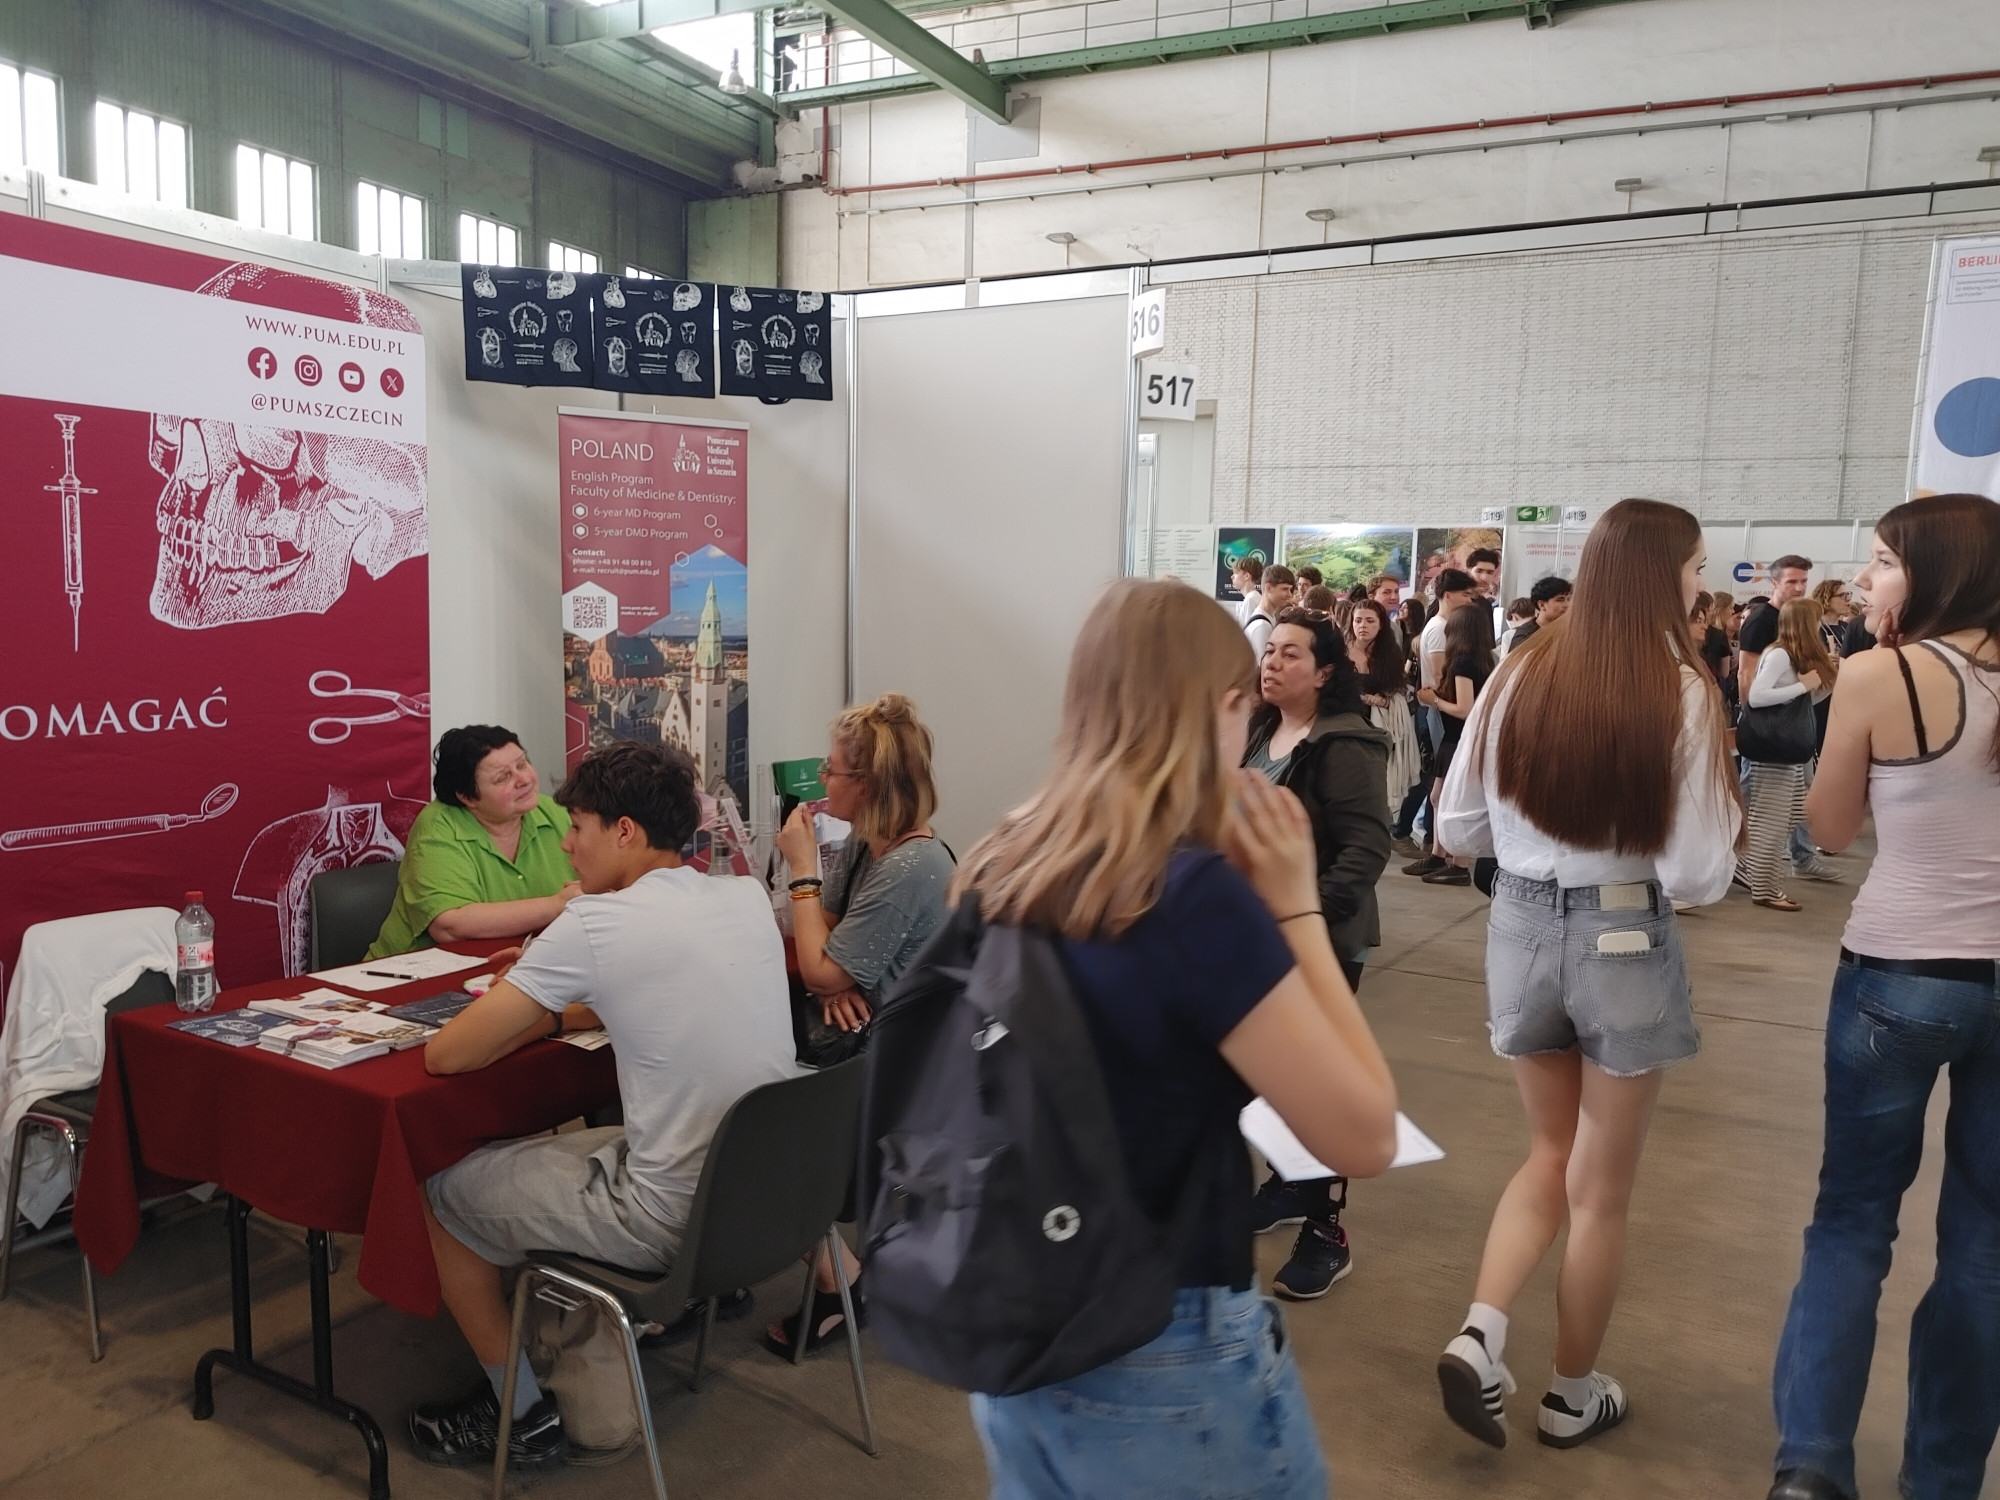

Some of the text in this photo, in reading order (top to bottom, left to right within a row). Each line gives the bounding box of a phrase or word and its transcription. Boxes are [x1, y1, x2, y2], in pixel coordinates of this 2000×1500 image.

[1959, 254, 2000, 268] BERLI
[1133, 303, 1160, 342] 516
[246, 315, 405, 355] WWW.PUM.EDU.PL
[1147, 374, 1194, 407] 517
[251, 393, 403, 427] @PUMSZCZECIN
[707, 435, 740, 446] Pomeranian
[571, 438, 654, 462] POLAND
[707, 445, 729, 455] Medical
[673, 461, 701, 474] PUM
[571, 470, 654, 486] English Program
[570, 485, 737, 505] Faculty of Medicine & Dentistry:
[593, 507, 681, 521] 6-year MD Program
[594, 526, 688, 541] 5-year DMD Program
[572, 548, 606, 557] Contact:
[572, 557, 597, 567] phone:
[0, 686, 228, 741] OMAGAĆ
